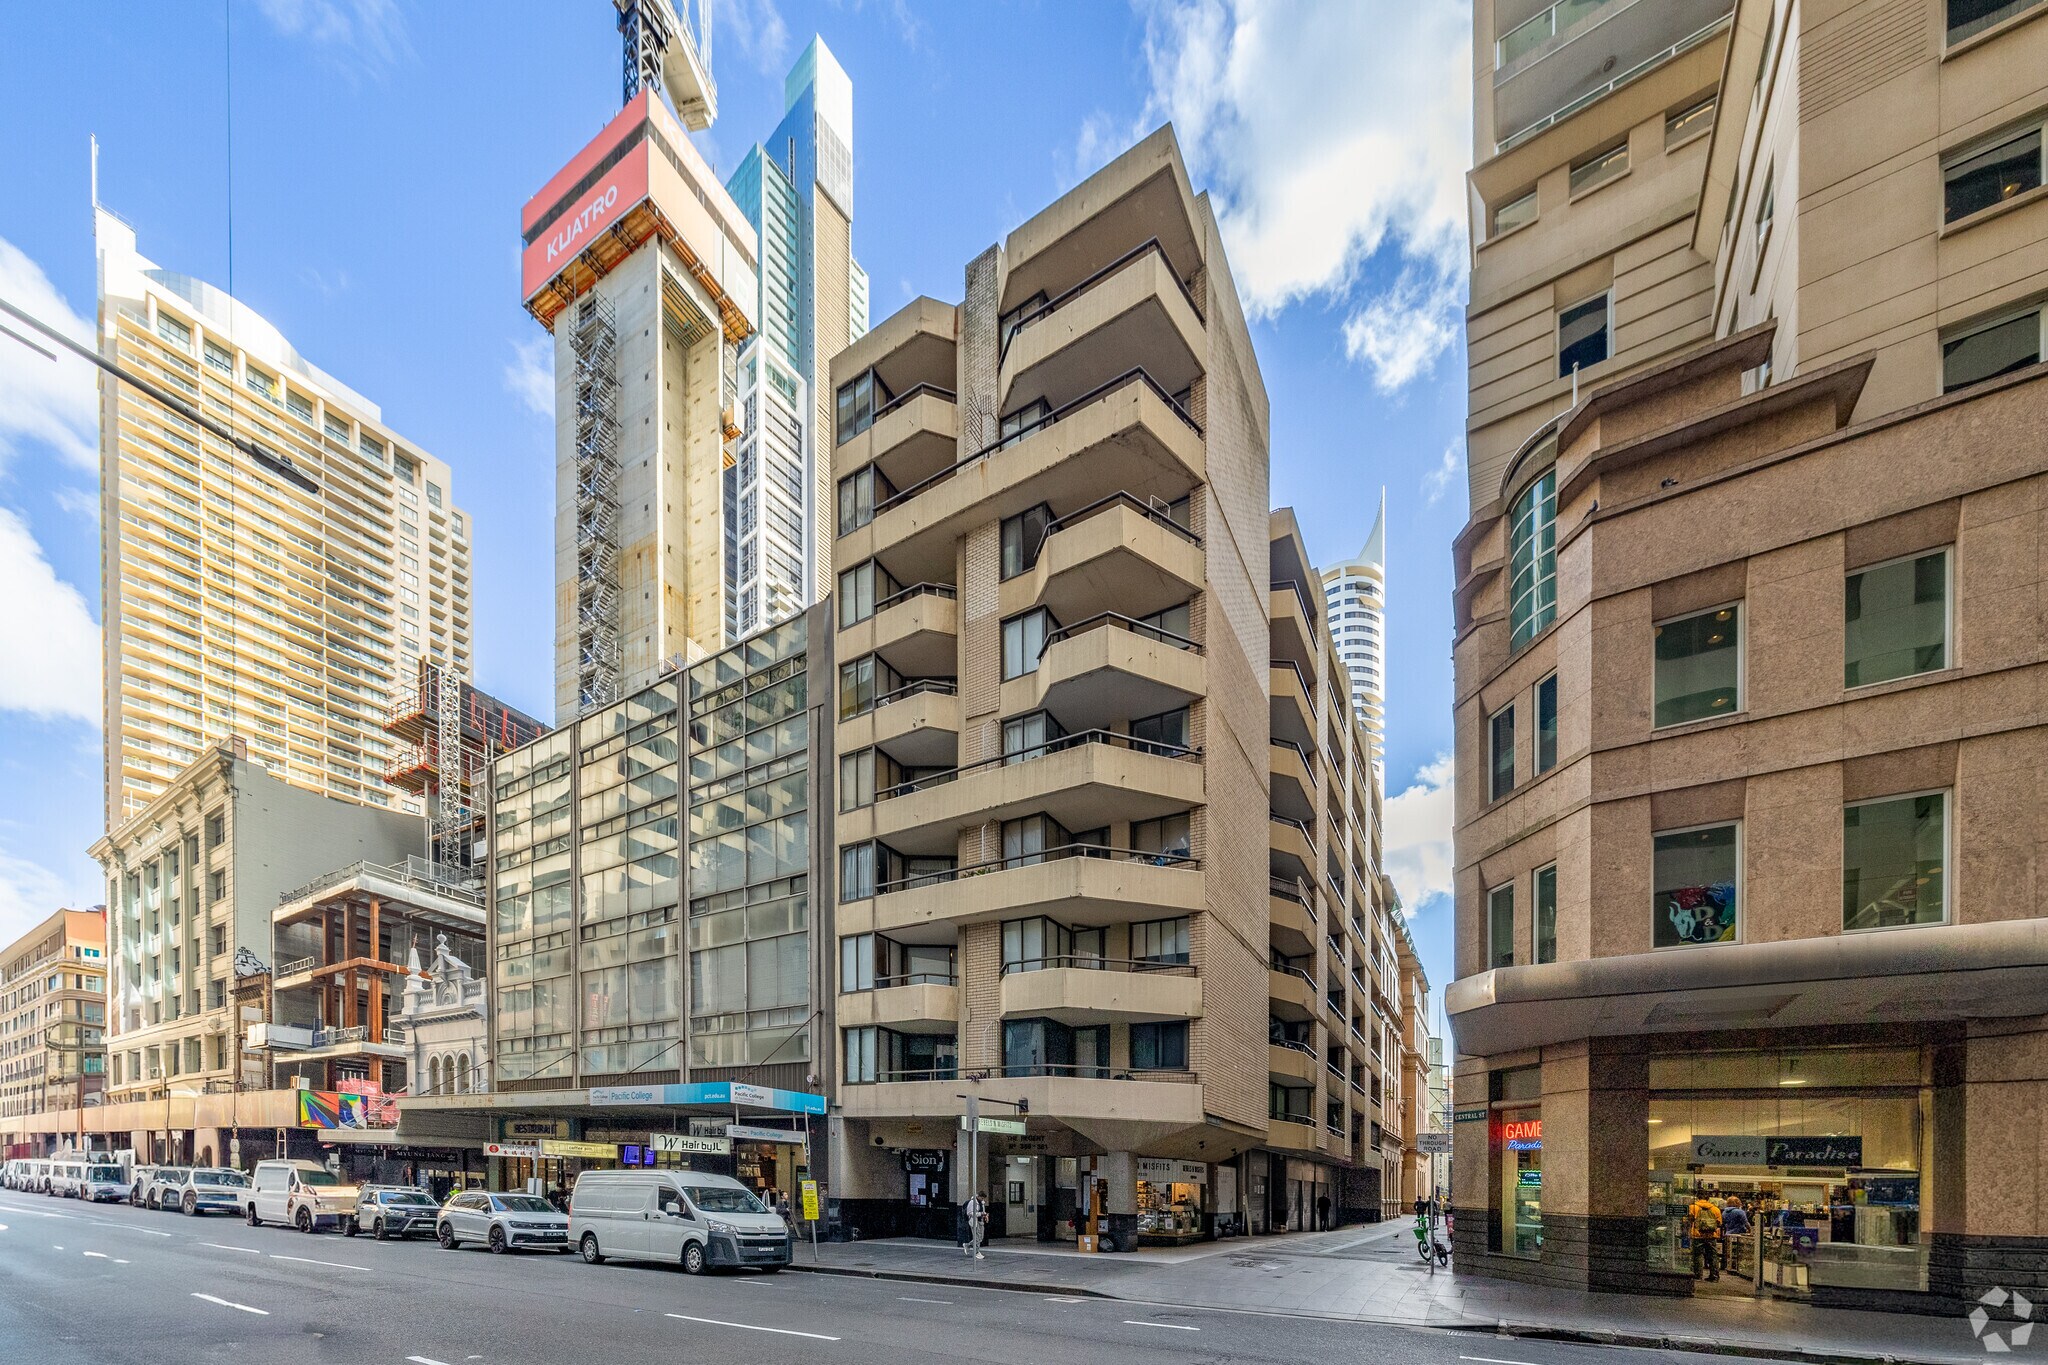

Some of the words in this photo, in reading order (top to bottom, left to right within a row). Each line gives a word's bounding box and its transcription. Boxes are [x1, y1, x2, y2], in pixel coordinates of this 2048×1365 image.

[546, 185, 618, 263] KUATRO
[611, 1091, 630, 1100] Pacific
[630, 1090, 653, 1101] College
[1455, 1113, 1478, 1121] CENTRAL
[704, 1126, 717, 1135] Hair
[766, 1131, 783, 1139] College
[659, 1134, 679, 1150] W
[681, 1140, 700, 1149] Hair
[701, 1141, 712, 1152] by
[1697, 1142, 1760, 1158] Games
[1770, 1142, 1859, 1160] Paradise
[911, 1153, 937, 1165] Sion
[1142, 1162, 1171, 1171] MISFITS
